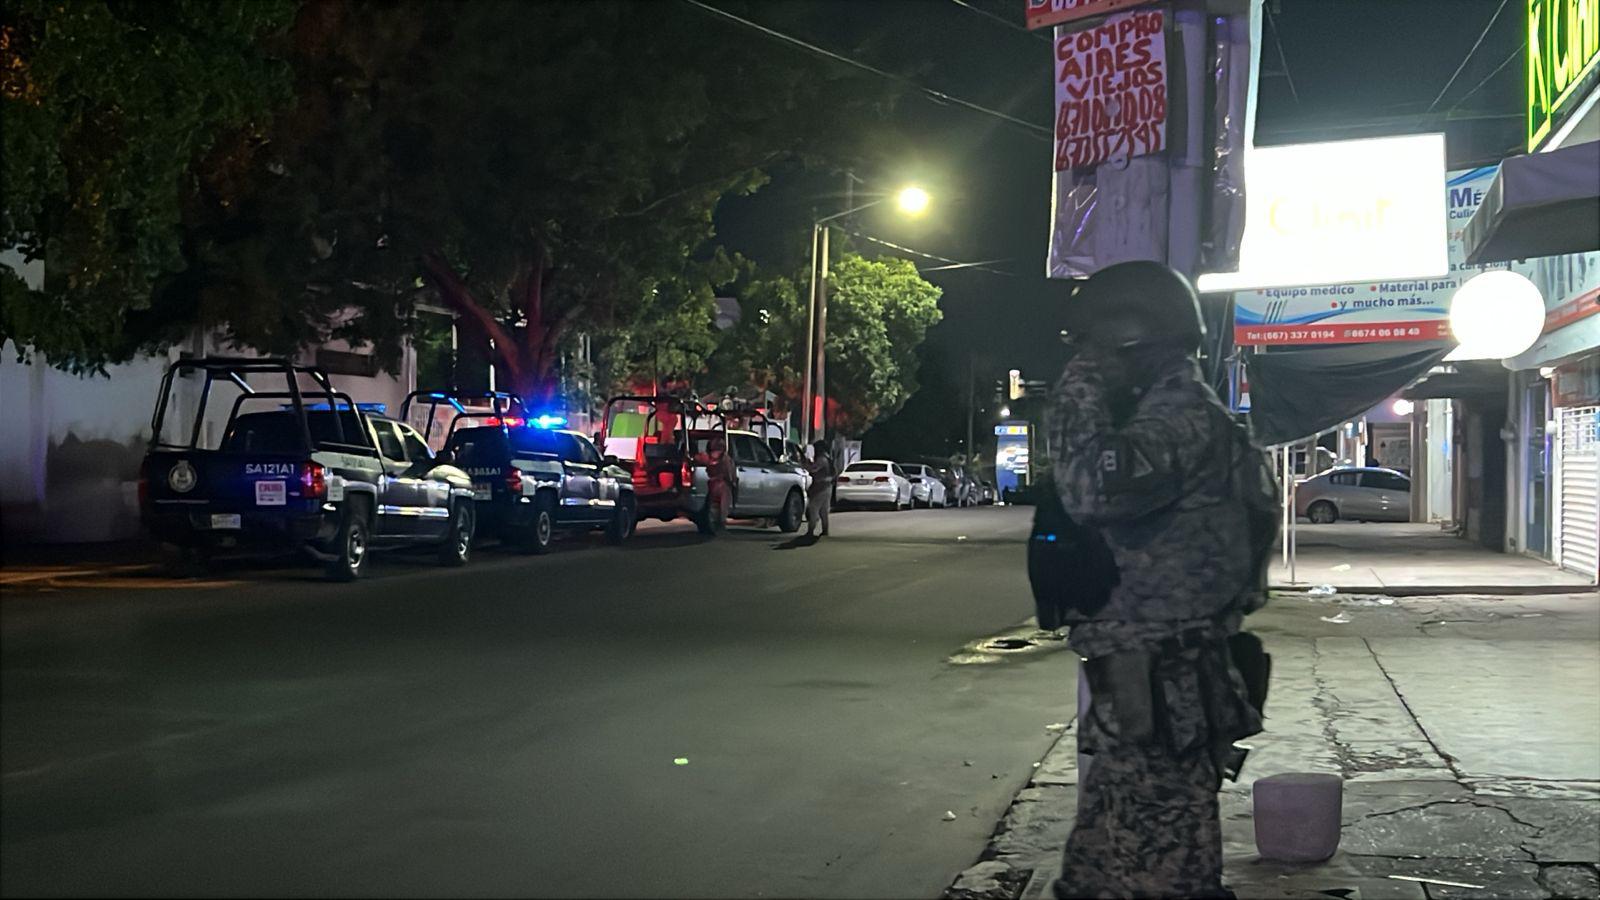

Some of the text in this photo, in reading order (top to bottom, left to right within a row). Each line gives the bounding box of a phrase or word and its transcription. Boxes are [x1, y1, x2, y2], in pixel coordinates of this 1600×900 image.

[1057, 12, 1163, 61] COMPRO
[1059, 38, 1152, 82] AIRES
[1066, 61, 1163, 99] VIEJOS
[1450, 187, 1485, 209] MÉ
[1265, 287, 1307, 298] Equipo
[1379, 281, 1428, 293] Material
[1431, 280, 1457, 292] para
[1339, 301, 1347, 311] y
[1353, 298, 1394, 308] mucho
[1290, 331, 1308, 339] 337
[245, 463, 295, 474] SA121A1
